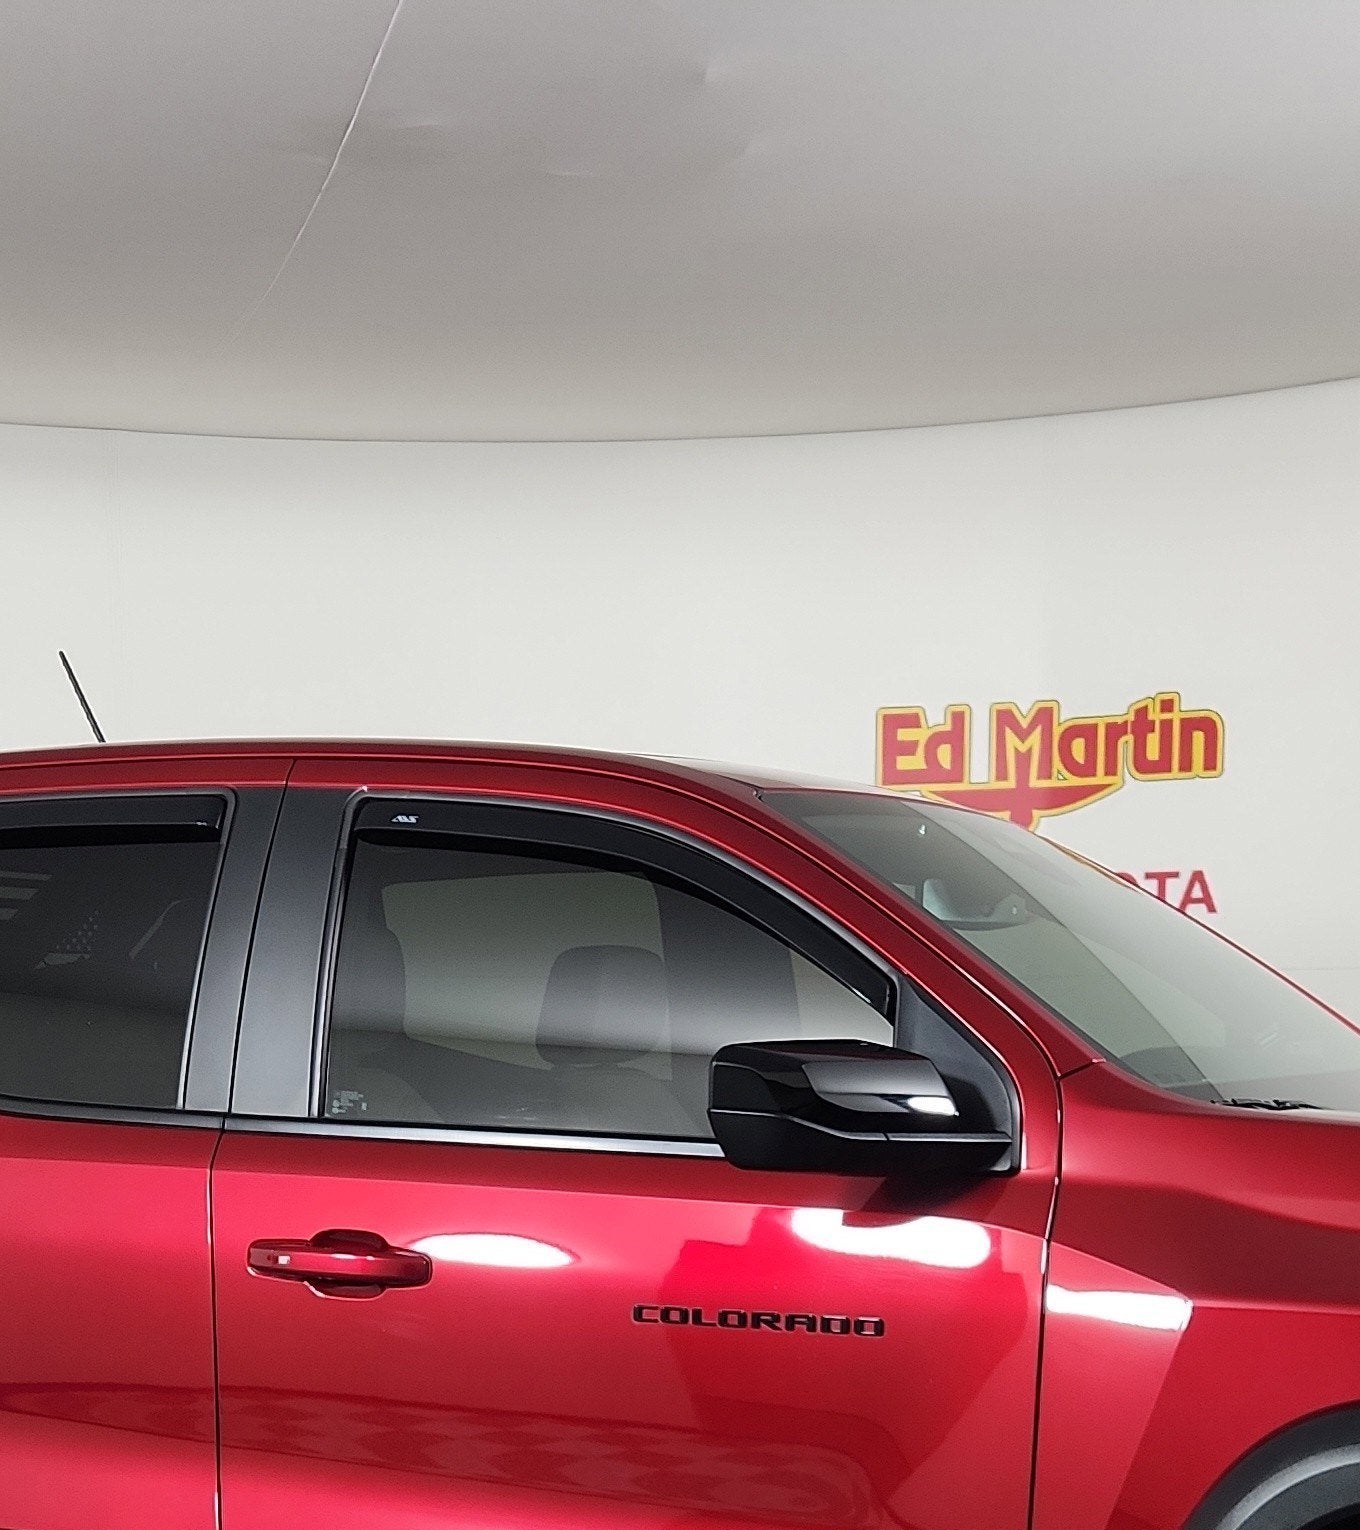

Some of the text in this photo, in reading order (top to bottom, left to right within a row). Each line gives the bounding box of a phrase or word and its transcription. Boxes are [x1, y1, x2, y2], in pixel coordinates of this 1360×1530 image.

[881, 697, 1219, 786] Ed Martin
[632, 1304, 886, 1338] COLORADO
